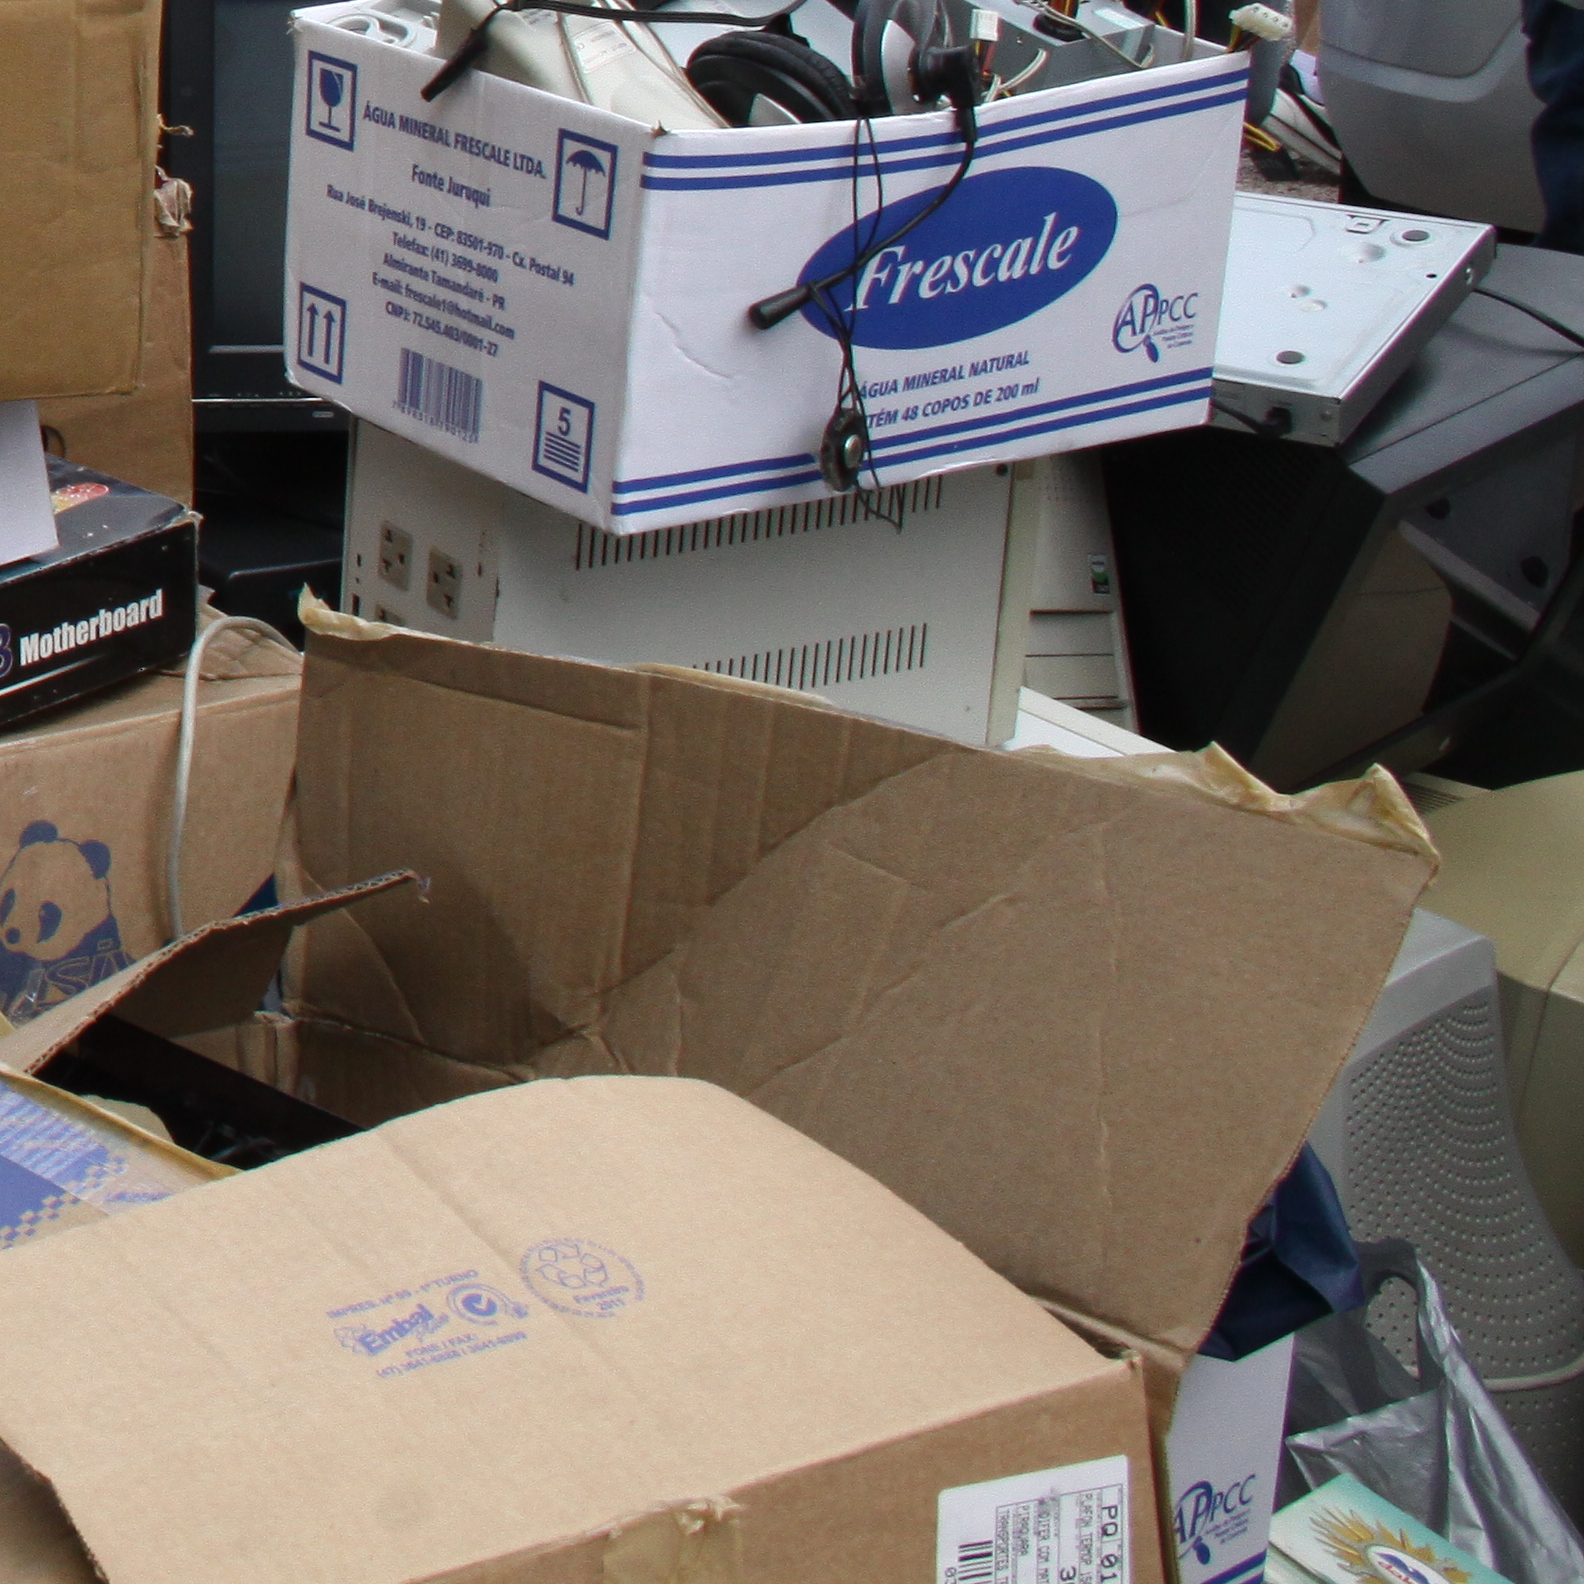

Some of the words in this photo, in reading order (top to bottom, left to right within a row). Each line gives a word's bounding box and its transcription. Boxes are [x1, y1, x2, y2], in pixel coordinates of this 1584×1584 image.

[363, 101, 395, 129] ÁGUA
[399, 115, 450, 148] MINERAL
[453, 131, 510, 168] FRESCALE
[513, 152, 547, 179] LTDA.
[411, 164, 444, 194] Fonte
[326, 184, 343, 202] Rua
[346, 191, 366, 211] José
[435, 222, 455, 243] CEP:
[529, 257, 561, 283] Postal
[431, 245, 450, 266] (41)
[383, 253, 430, 283] Almirante
[431, 270, 485, 304] Tamandaré
[492, 293, 507, 311] PR
[843, 211, 1081, 313] Frescale
[858, 379, 898, 400] ÁGUA
[903, 364, 966, 392] MINERAL
[969, 350, 1030, 378] NATURAL
[901, 405, 919, 422] 48
[921, 395, 969, 419] COPOS
[973, 390, 993, 410] DE
[996, 385, 1017, 405] 200
[1018, 377, 1041, 397] ml
[558, 407, 572, 437] 5
[19, 589, 165, 668] Motherboard
[357, 1303, 436, 1357] Embal
[997, 1509, 1010, 1570] TRANSPORTES
[1101, 1504, 1119, 1537] PQ
